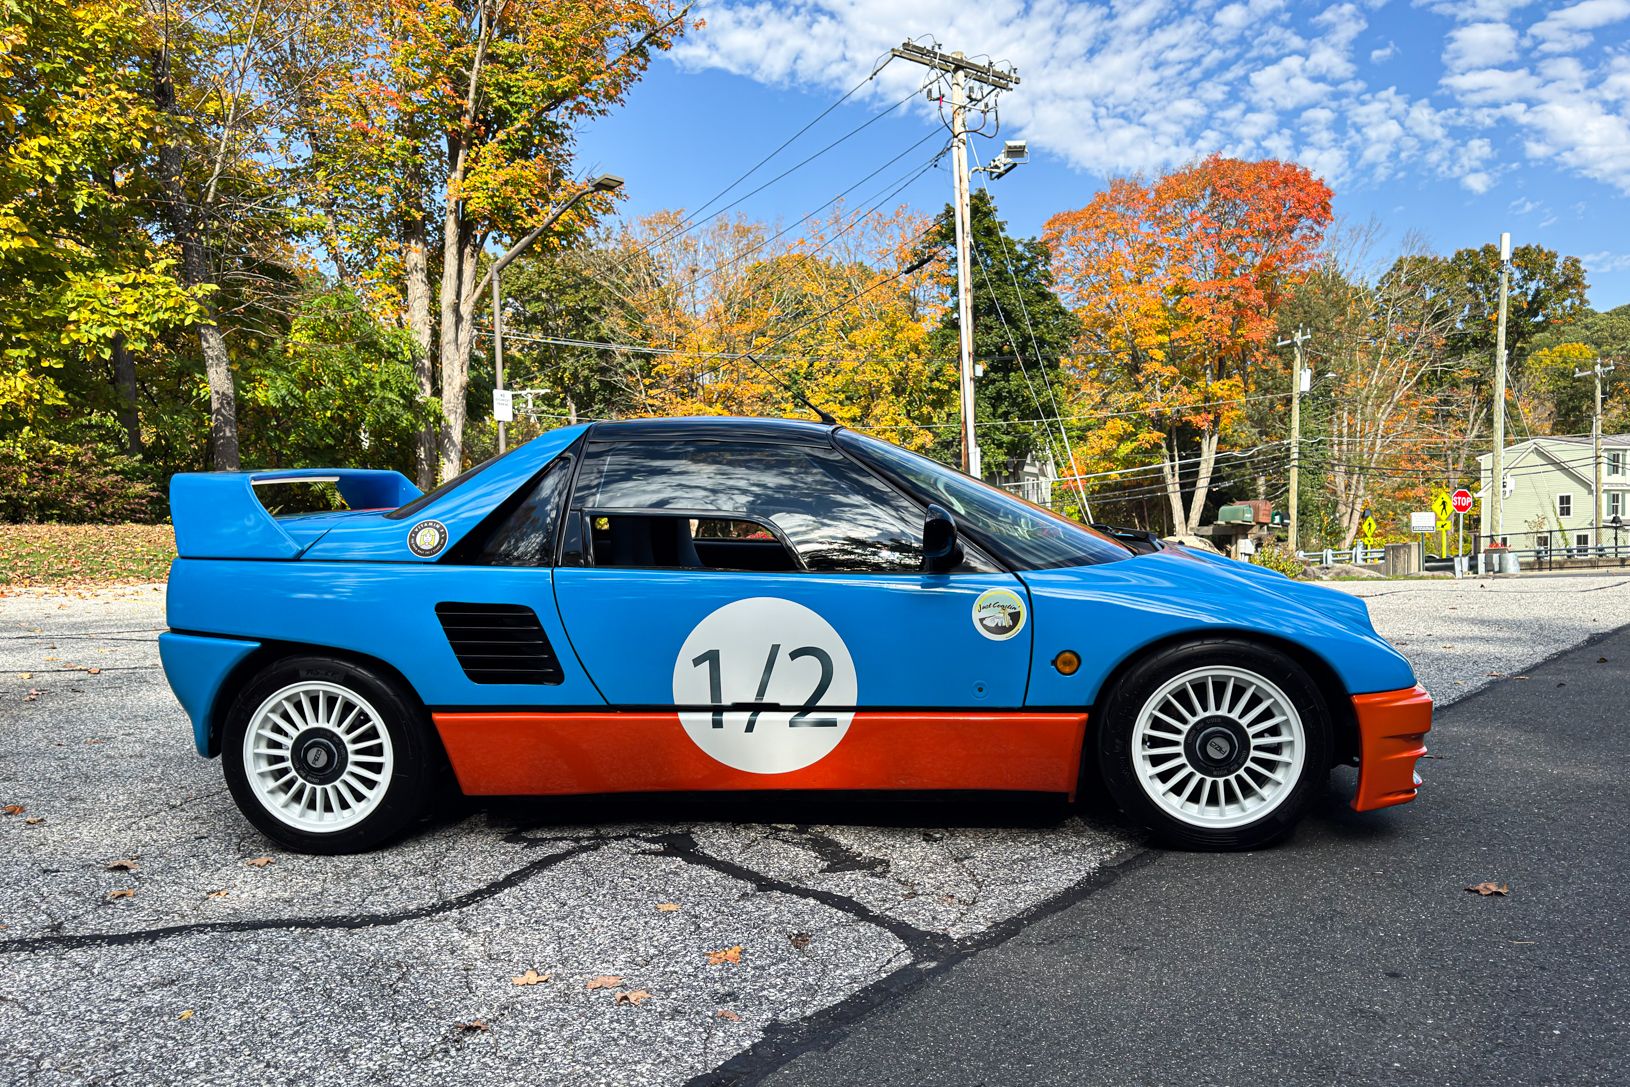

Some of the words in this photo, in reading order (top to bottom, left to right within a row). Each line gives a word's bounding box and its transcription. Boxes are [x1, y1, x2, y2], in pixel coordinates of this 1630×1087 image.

[1452, 497, 1471, 506] STOP
[414, 522, 440, 531] VITAMIN
[978, 603, 992, 612] Just
[692, 643, 838, 733] 1/2
